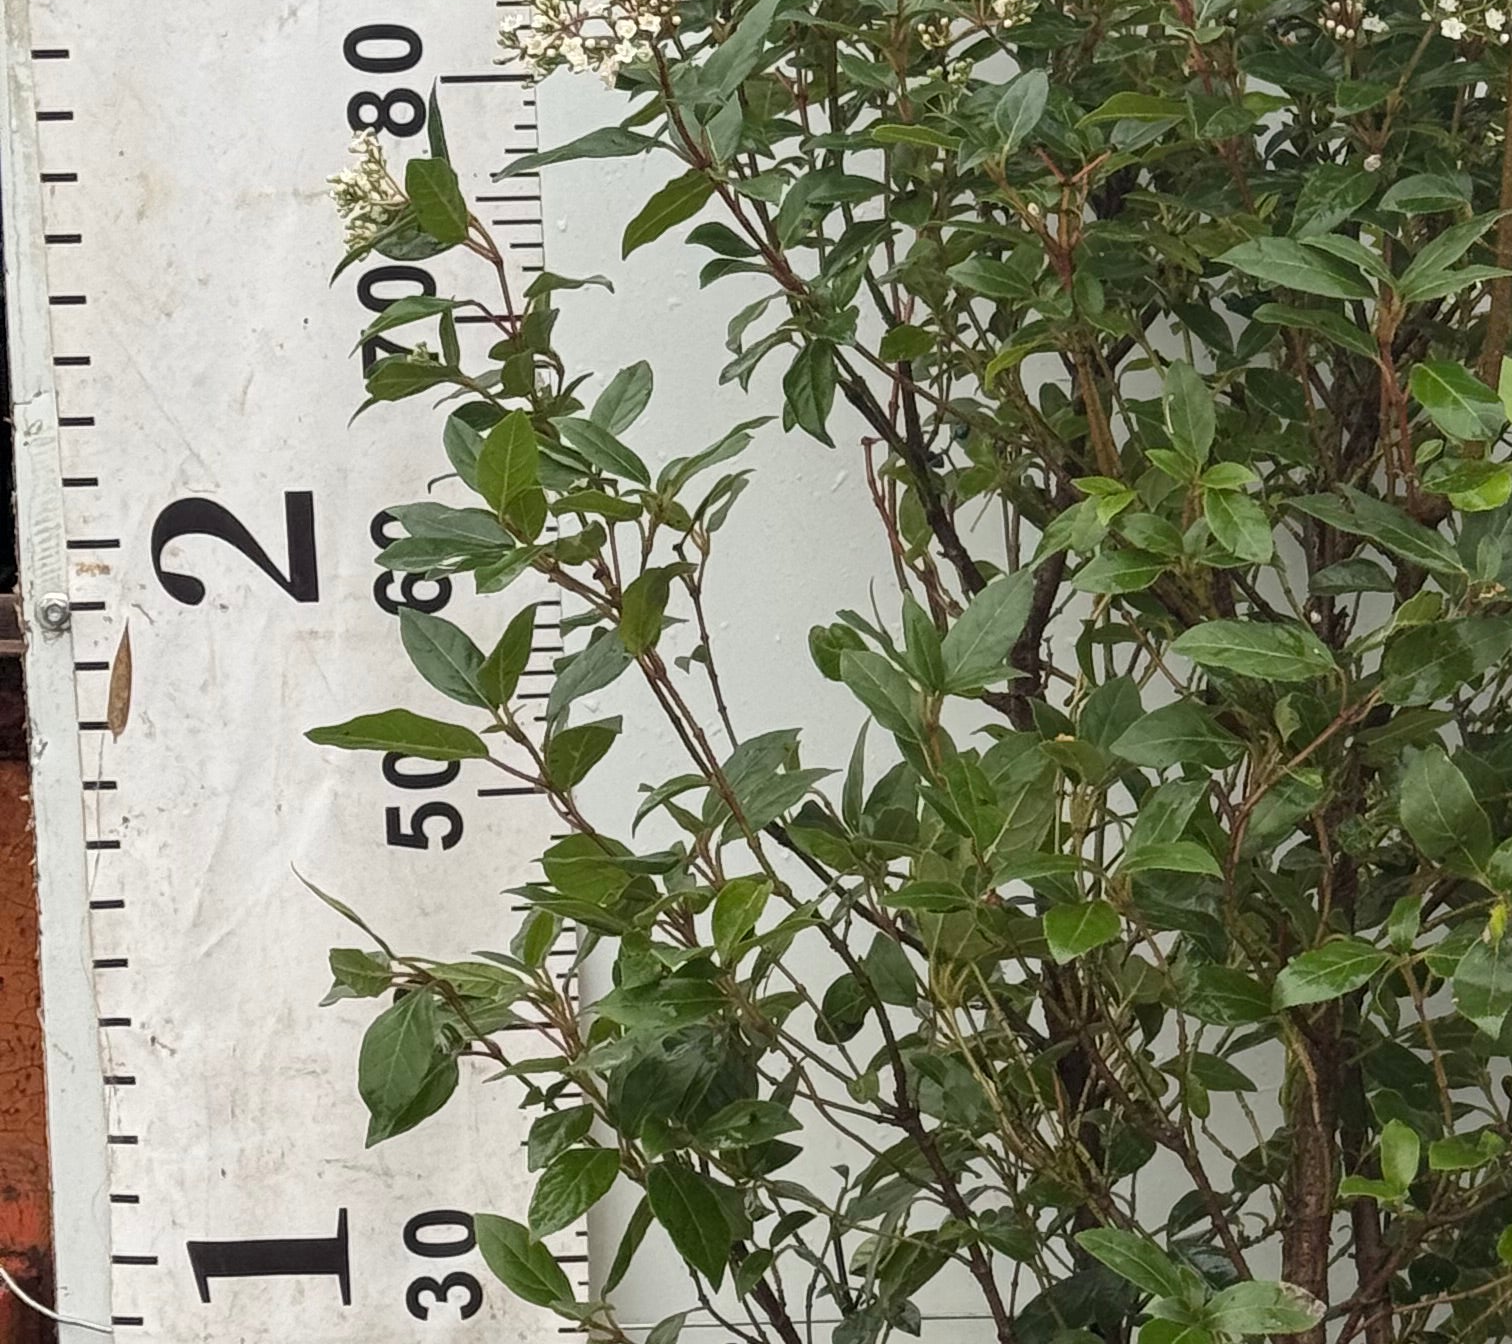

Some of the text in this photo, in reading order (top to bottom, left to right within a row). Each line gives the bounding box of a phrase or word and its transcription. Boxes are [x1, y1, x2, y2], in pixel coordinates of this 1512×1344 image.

[343, 24, 427, 138] 80
[151, 490, 319, 606] 2
[382, 750, 464, 851] 50
[187, 1207, 351, 1306] 1
[403, 1209, 484, 1321] 30
